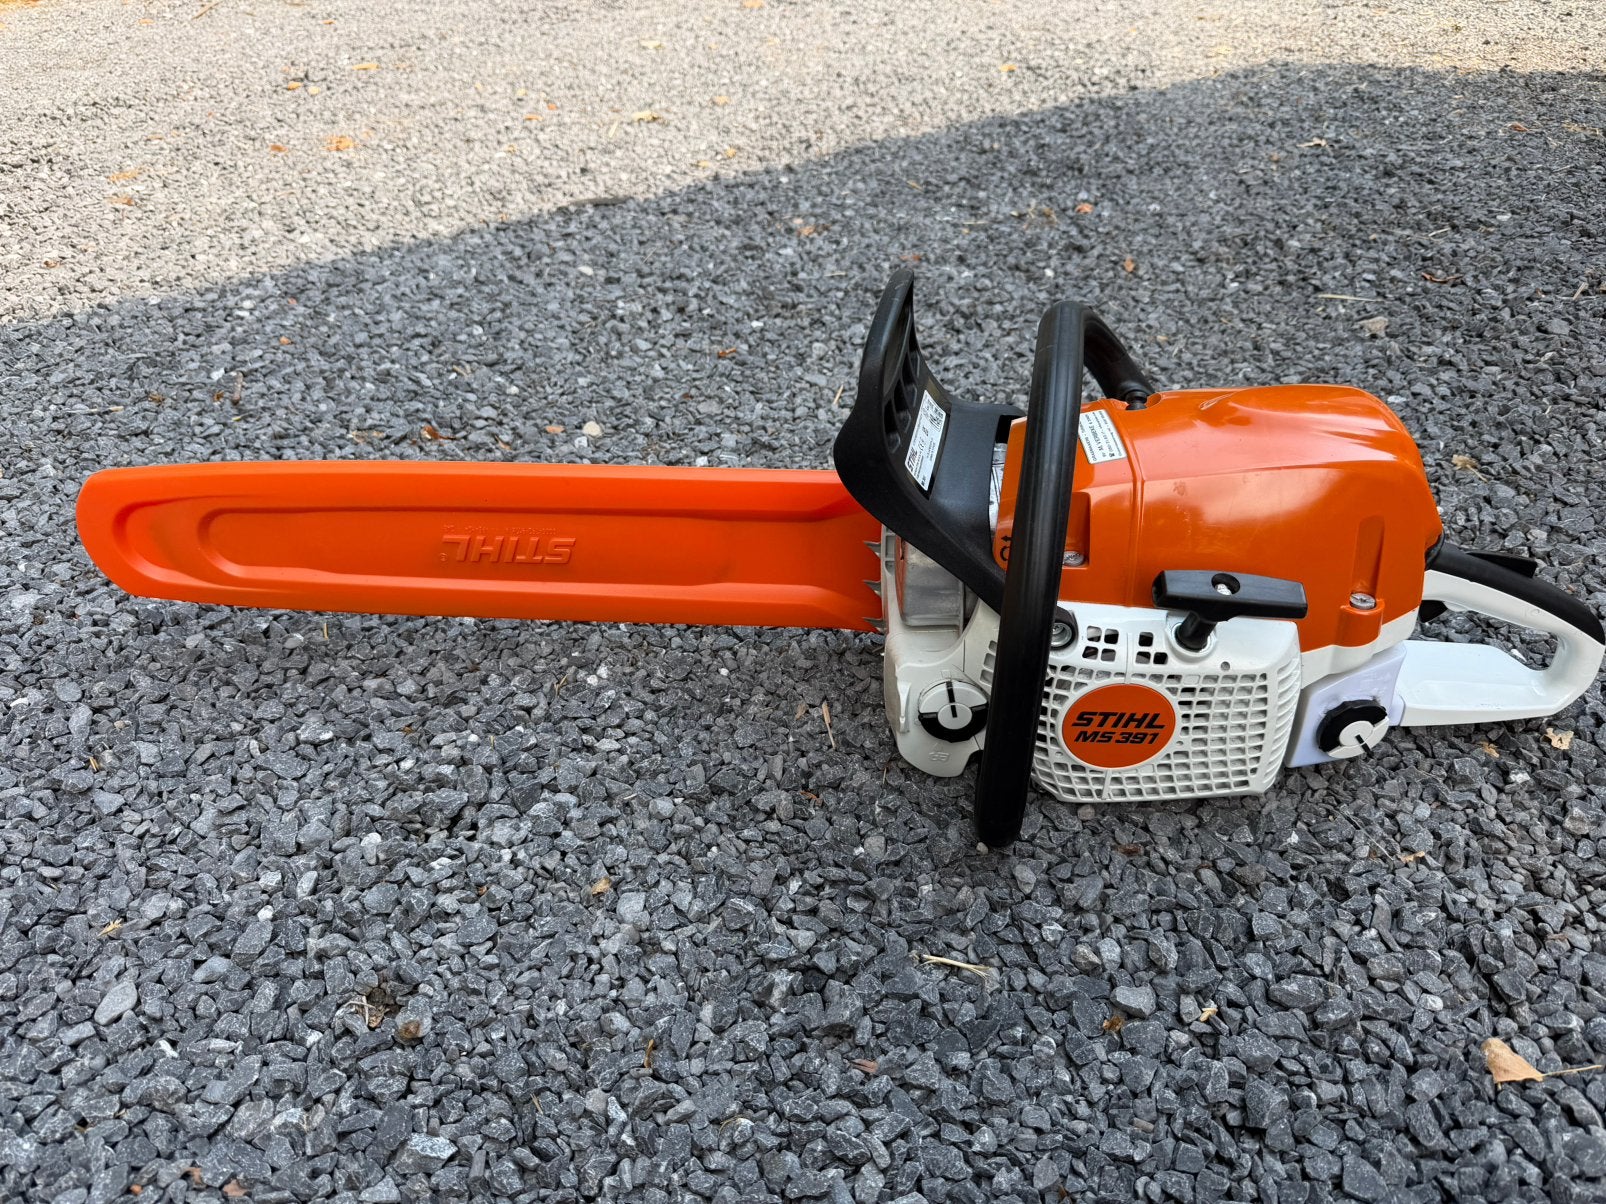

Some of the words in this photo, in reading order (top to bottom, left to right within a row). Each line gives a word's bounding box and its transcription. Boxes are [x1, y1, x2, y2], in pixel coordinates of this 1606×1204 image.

[442, 534, 576, 564] STIHL
[1071, 711, 1166, 729] STIHL
[1074, 731, 1116, 743] MS
[1115, 732, 1160, 744] 391
